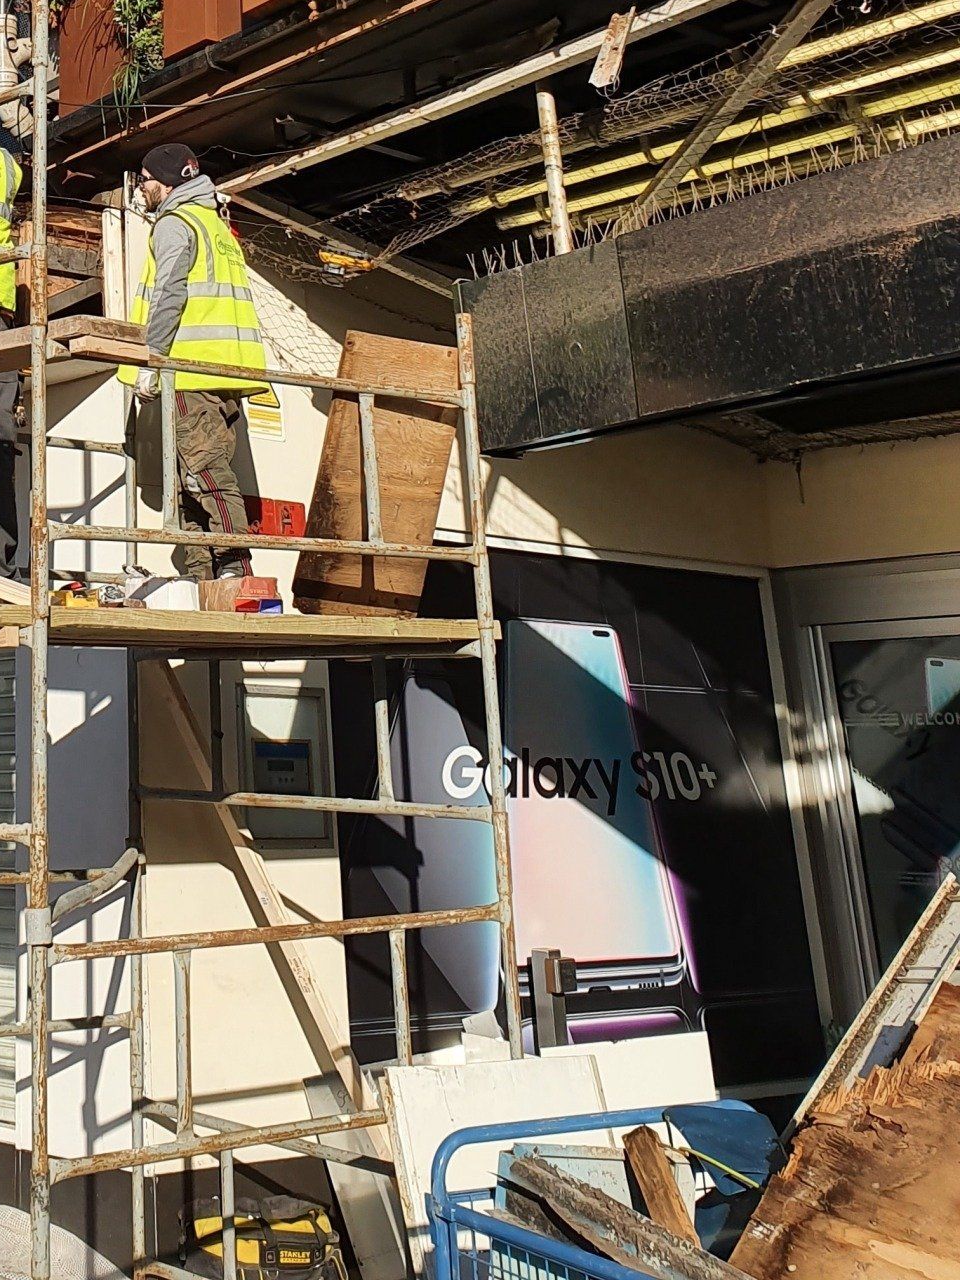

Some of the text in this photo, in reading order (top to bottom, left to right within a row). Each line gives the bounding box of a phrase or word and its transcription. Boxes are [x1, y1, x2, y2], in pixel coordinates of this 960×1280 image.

[441, 745, 718, 816] Galaxy S10+
[280, 1250, 310, 1258] STANLEY
